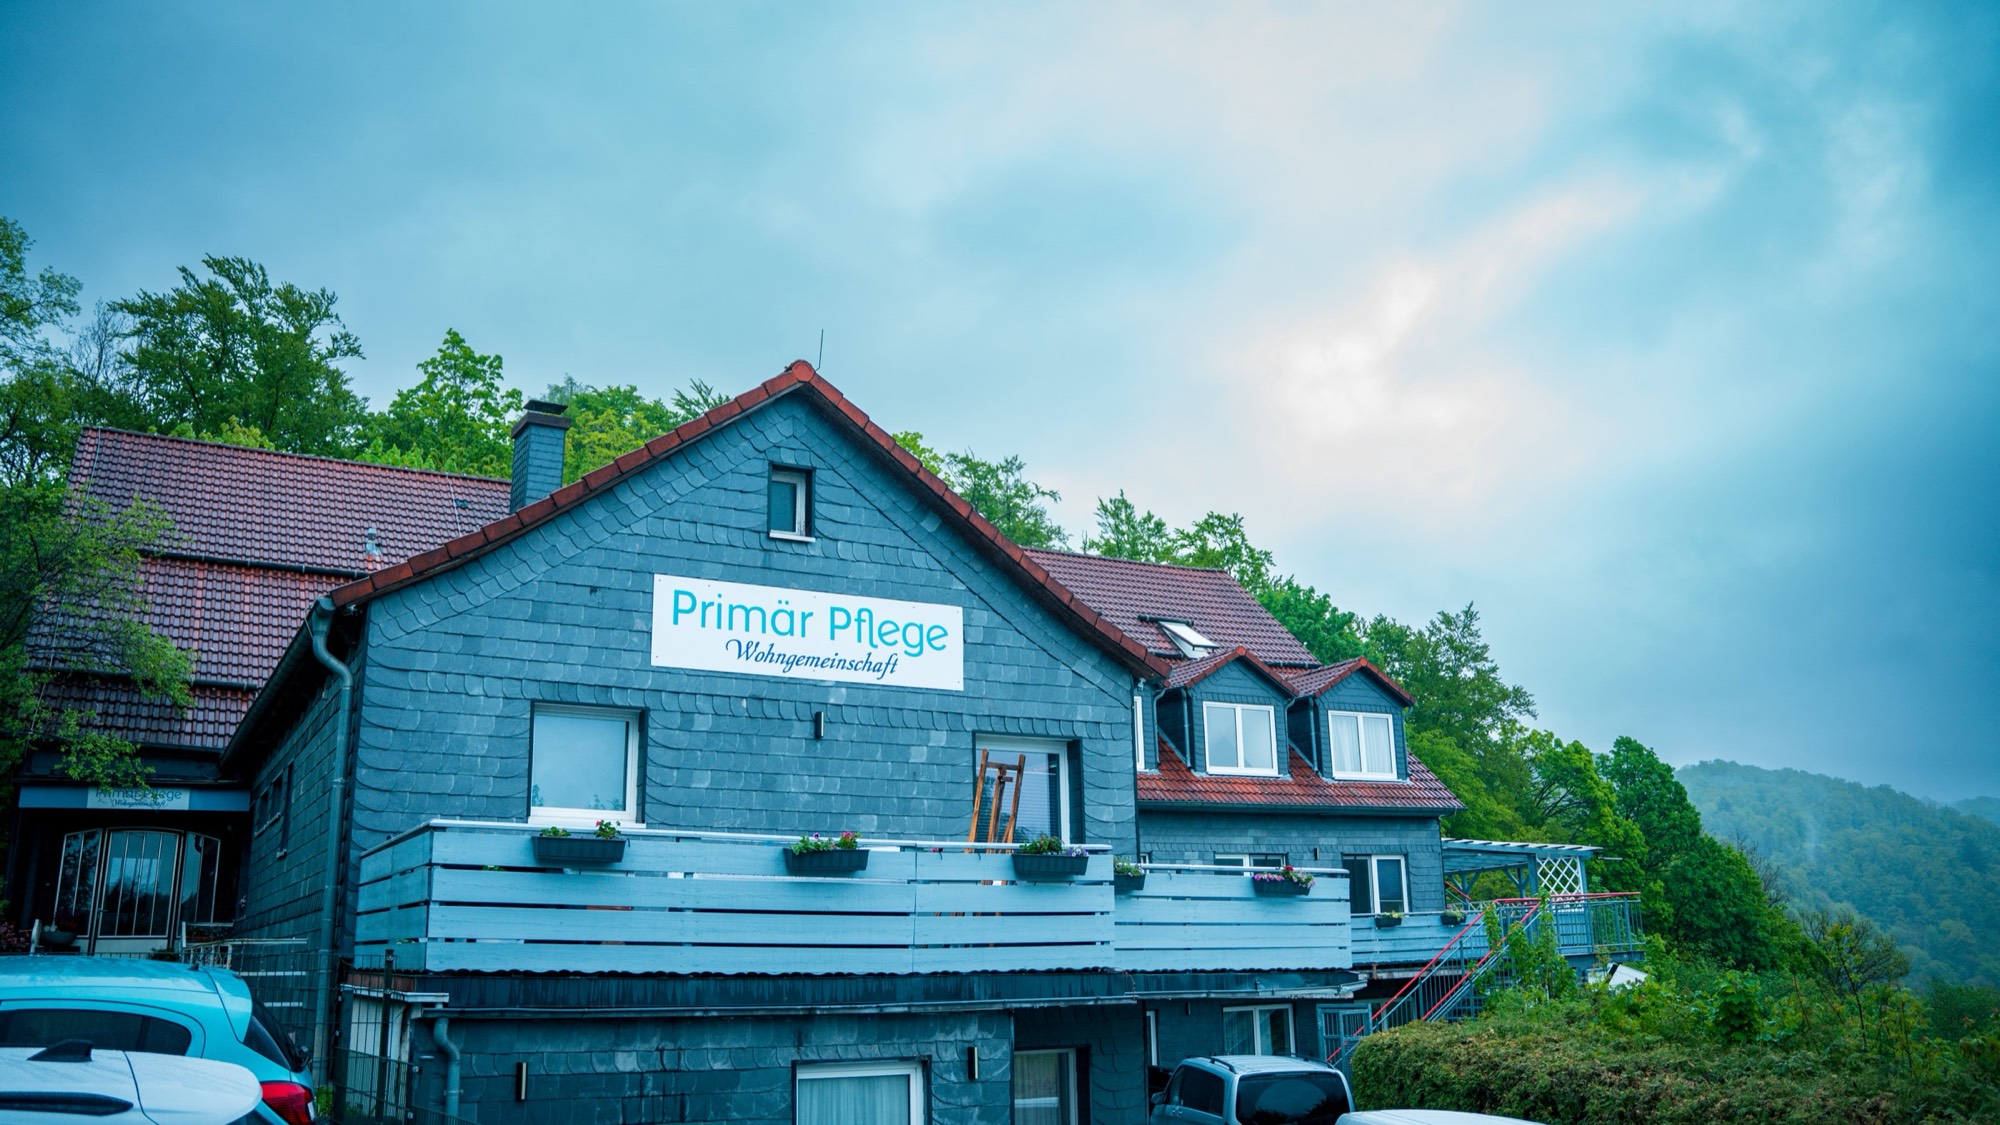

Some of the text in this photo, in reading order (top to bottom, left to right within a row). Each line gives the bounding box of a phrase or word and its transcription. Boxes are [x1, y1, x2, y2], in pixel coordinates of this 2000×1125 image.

[672, 589, 949, 658] Primär Pflege
[725, 639, 898, 680] Wohngemeinschaft
